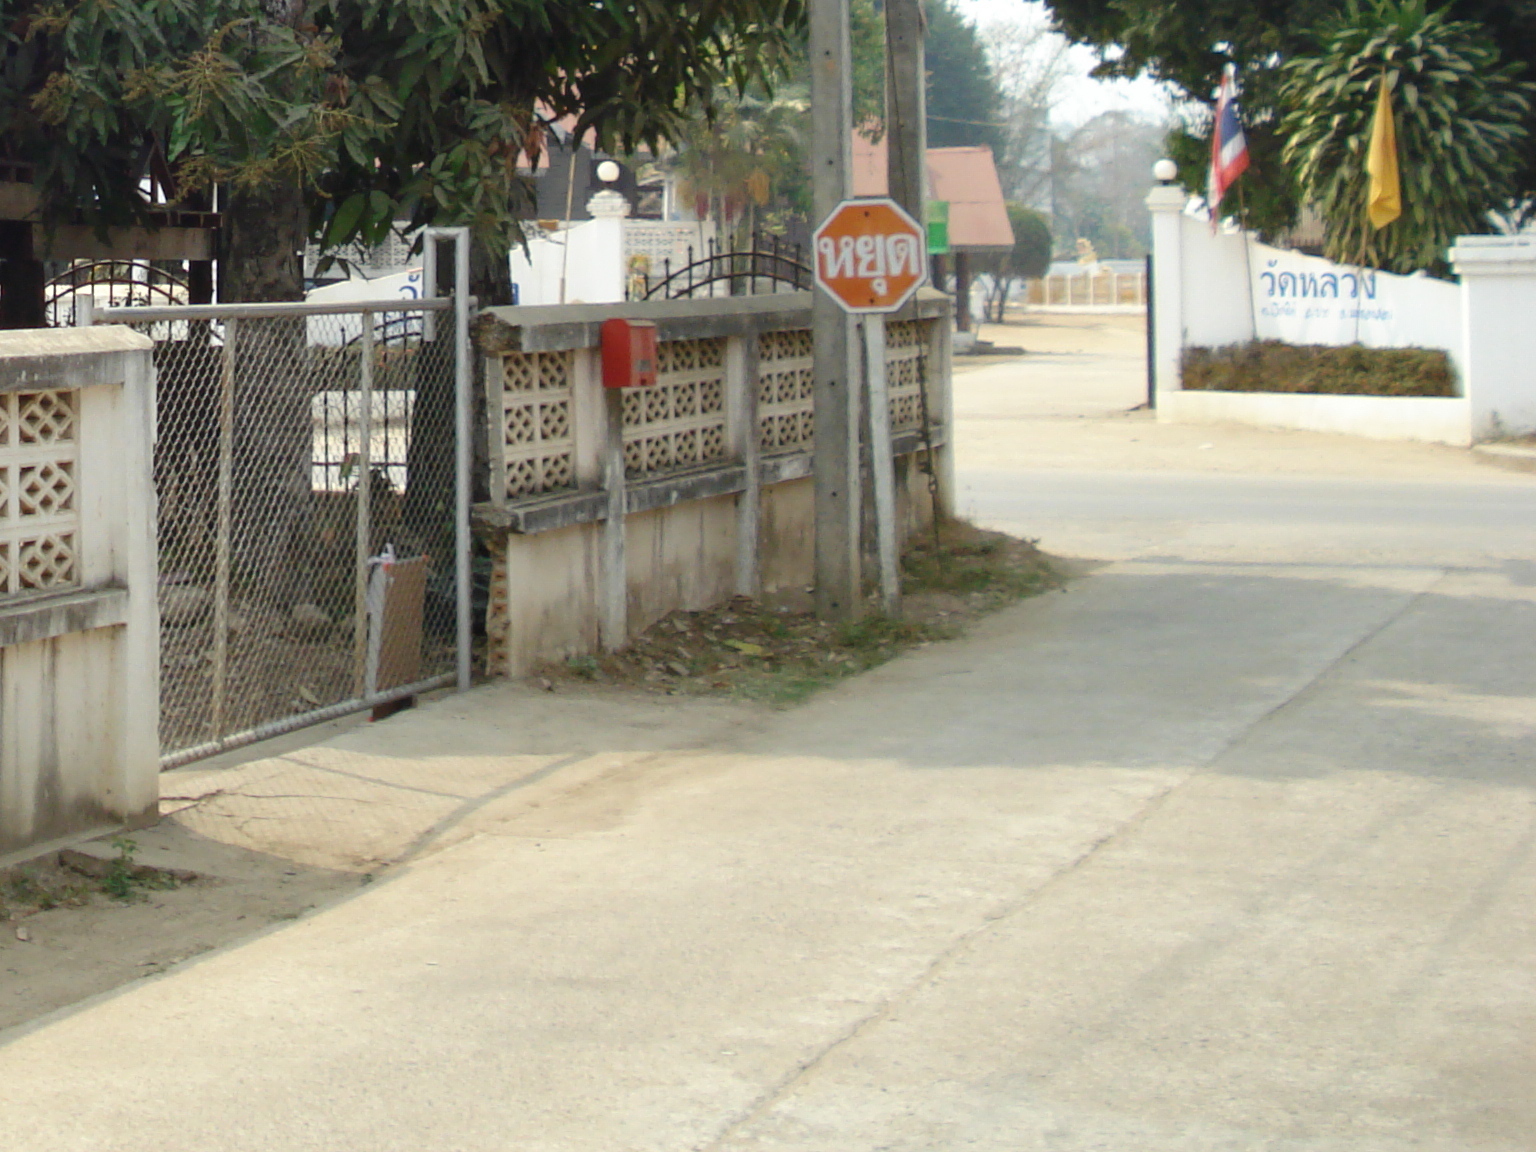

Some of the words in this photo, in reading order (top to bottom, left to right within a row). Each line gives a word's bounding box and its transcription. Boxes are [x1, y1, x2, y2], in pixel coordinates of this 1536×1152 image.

[819, 233, 920, 297] หยุด
[1260, 258, 1377, 300] วัดหลวง
